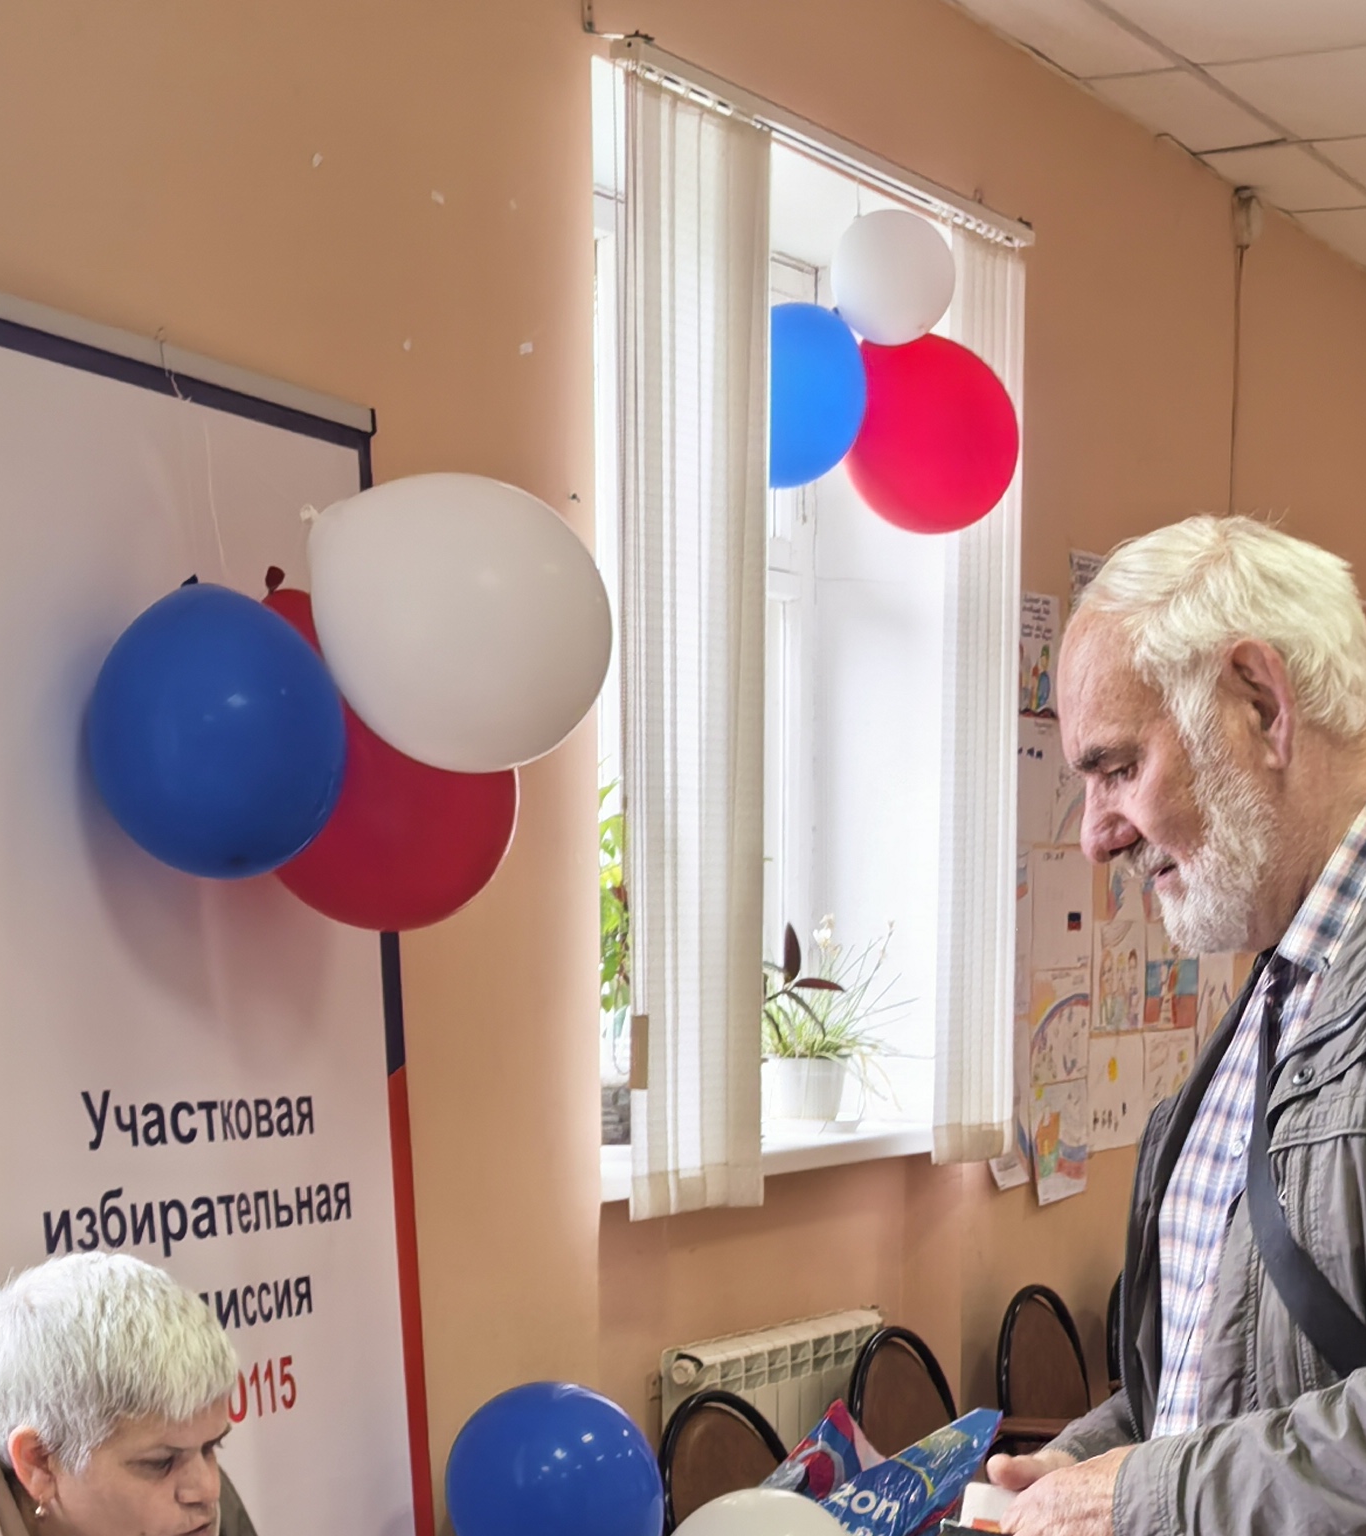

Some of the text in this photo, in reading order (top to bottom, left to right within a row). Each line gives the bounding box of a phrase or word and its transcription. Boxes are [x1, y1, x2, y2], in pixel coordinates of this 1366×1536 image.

[80, 1089, 316, 1151] Участковая
[42, 1180, 353, 1257] избирательная
[199, 1275, 314, 1329] иссия
